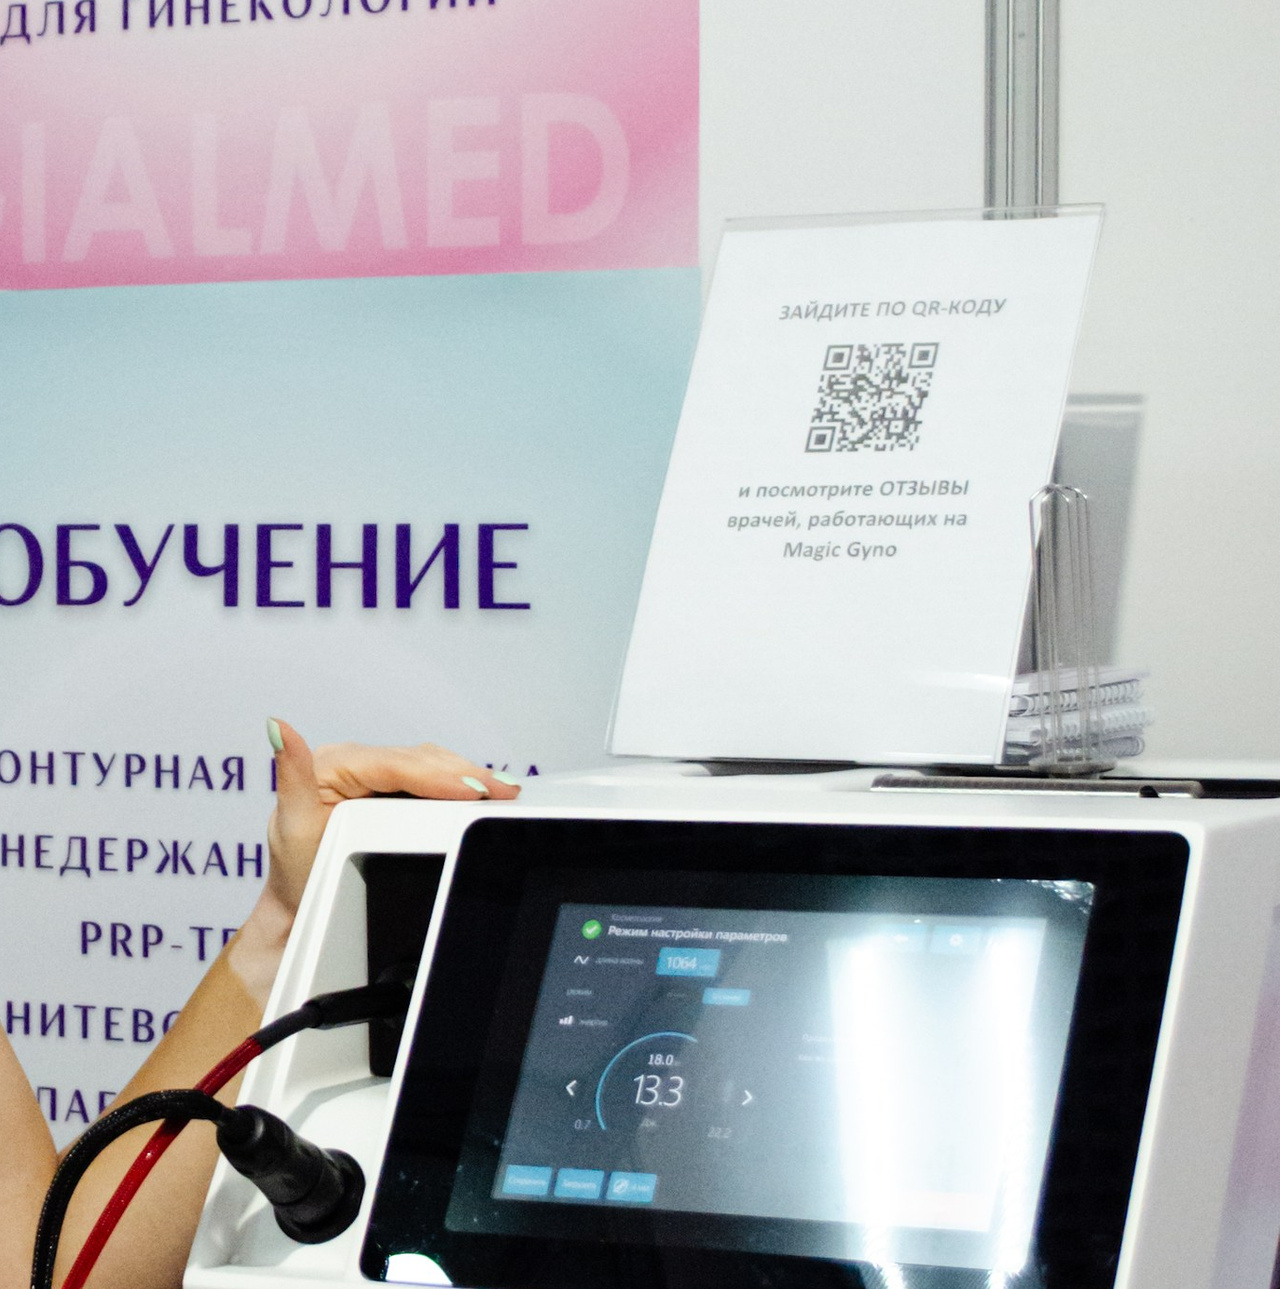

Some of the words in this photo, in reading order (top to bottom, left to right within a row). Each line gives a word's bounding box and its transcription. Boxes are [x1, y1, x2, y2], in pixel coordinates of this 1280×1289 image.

[778, 297, 870, 322] ЗАЙДИТЕ
[876, 300, 907, 318] ПО
[911, 297, 1008, 320] QR-КОДУ
[738, 486, 752, 498] и
[756, 482, 874, 501] посмотрите
[879, 478, 970, 497] ОТЗЫВЫ
[727, 511, 802, 530] врачей,
[808, 511, 938, 530] работающих
[944, 512, 968, 526] на
[783, 540, 841, 561] Magic
[846, 541, 898, 560] Gyno
[608, 925, 649, 937] Режим
[651, 928, 713, 941] настройки
[716, 931, 789, 944] параметров
[667, 956, 698, 970] 1064
[648, 1054, 674, 1066] 18.0
[633, 1073, 684, 1107] 13.3
[574, 1119, 592, 1131] 0.7
